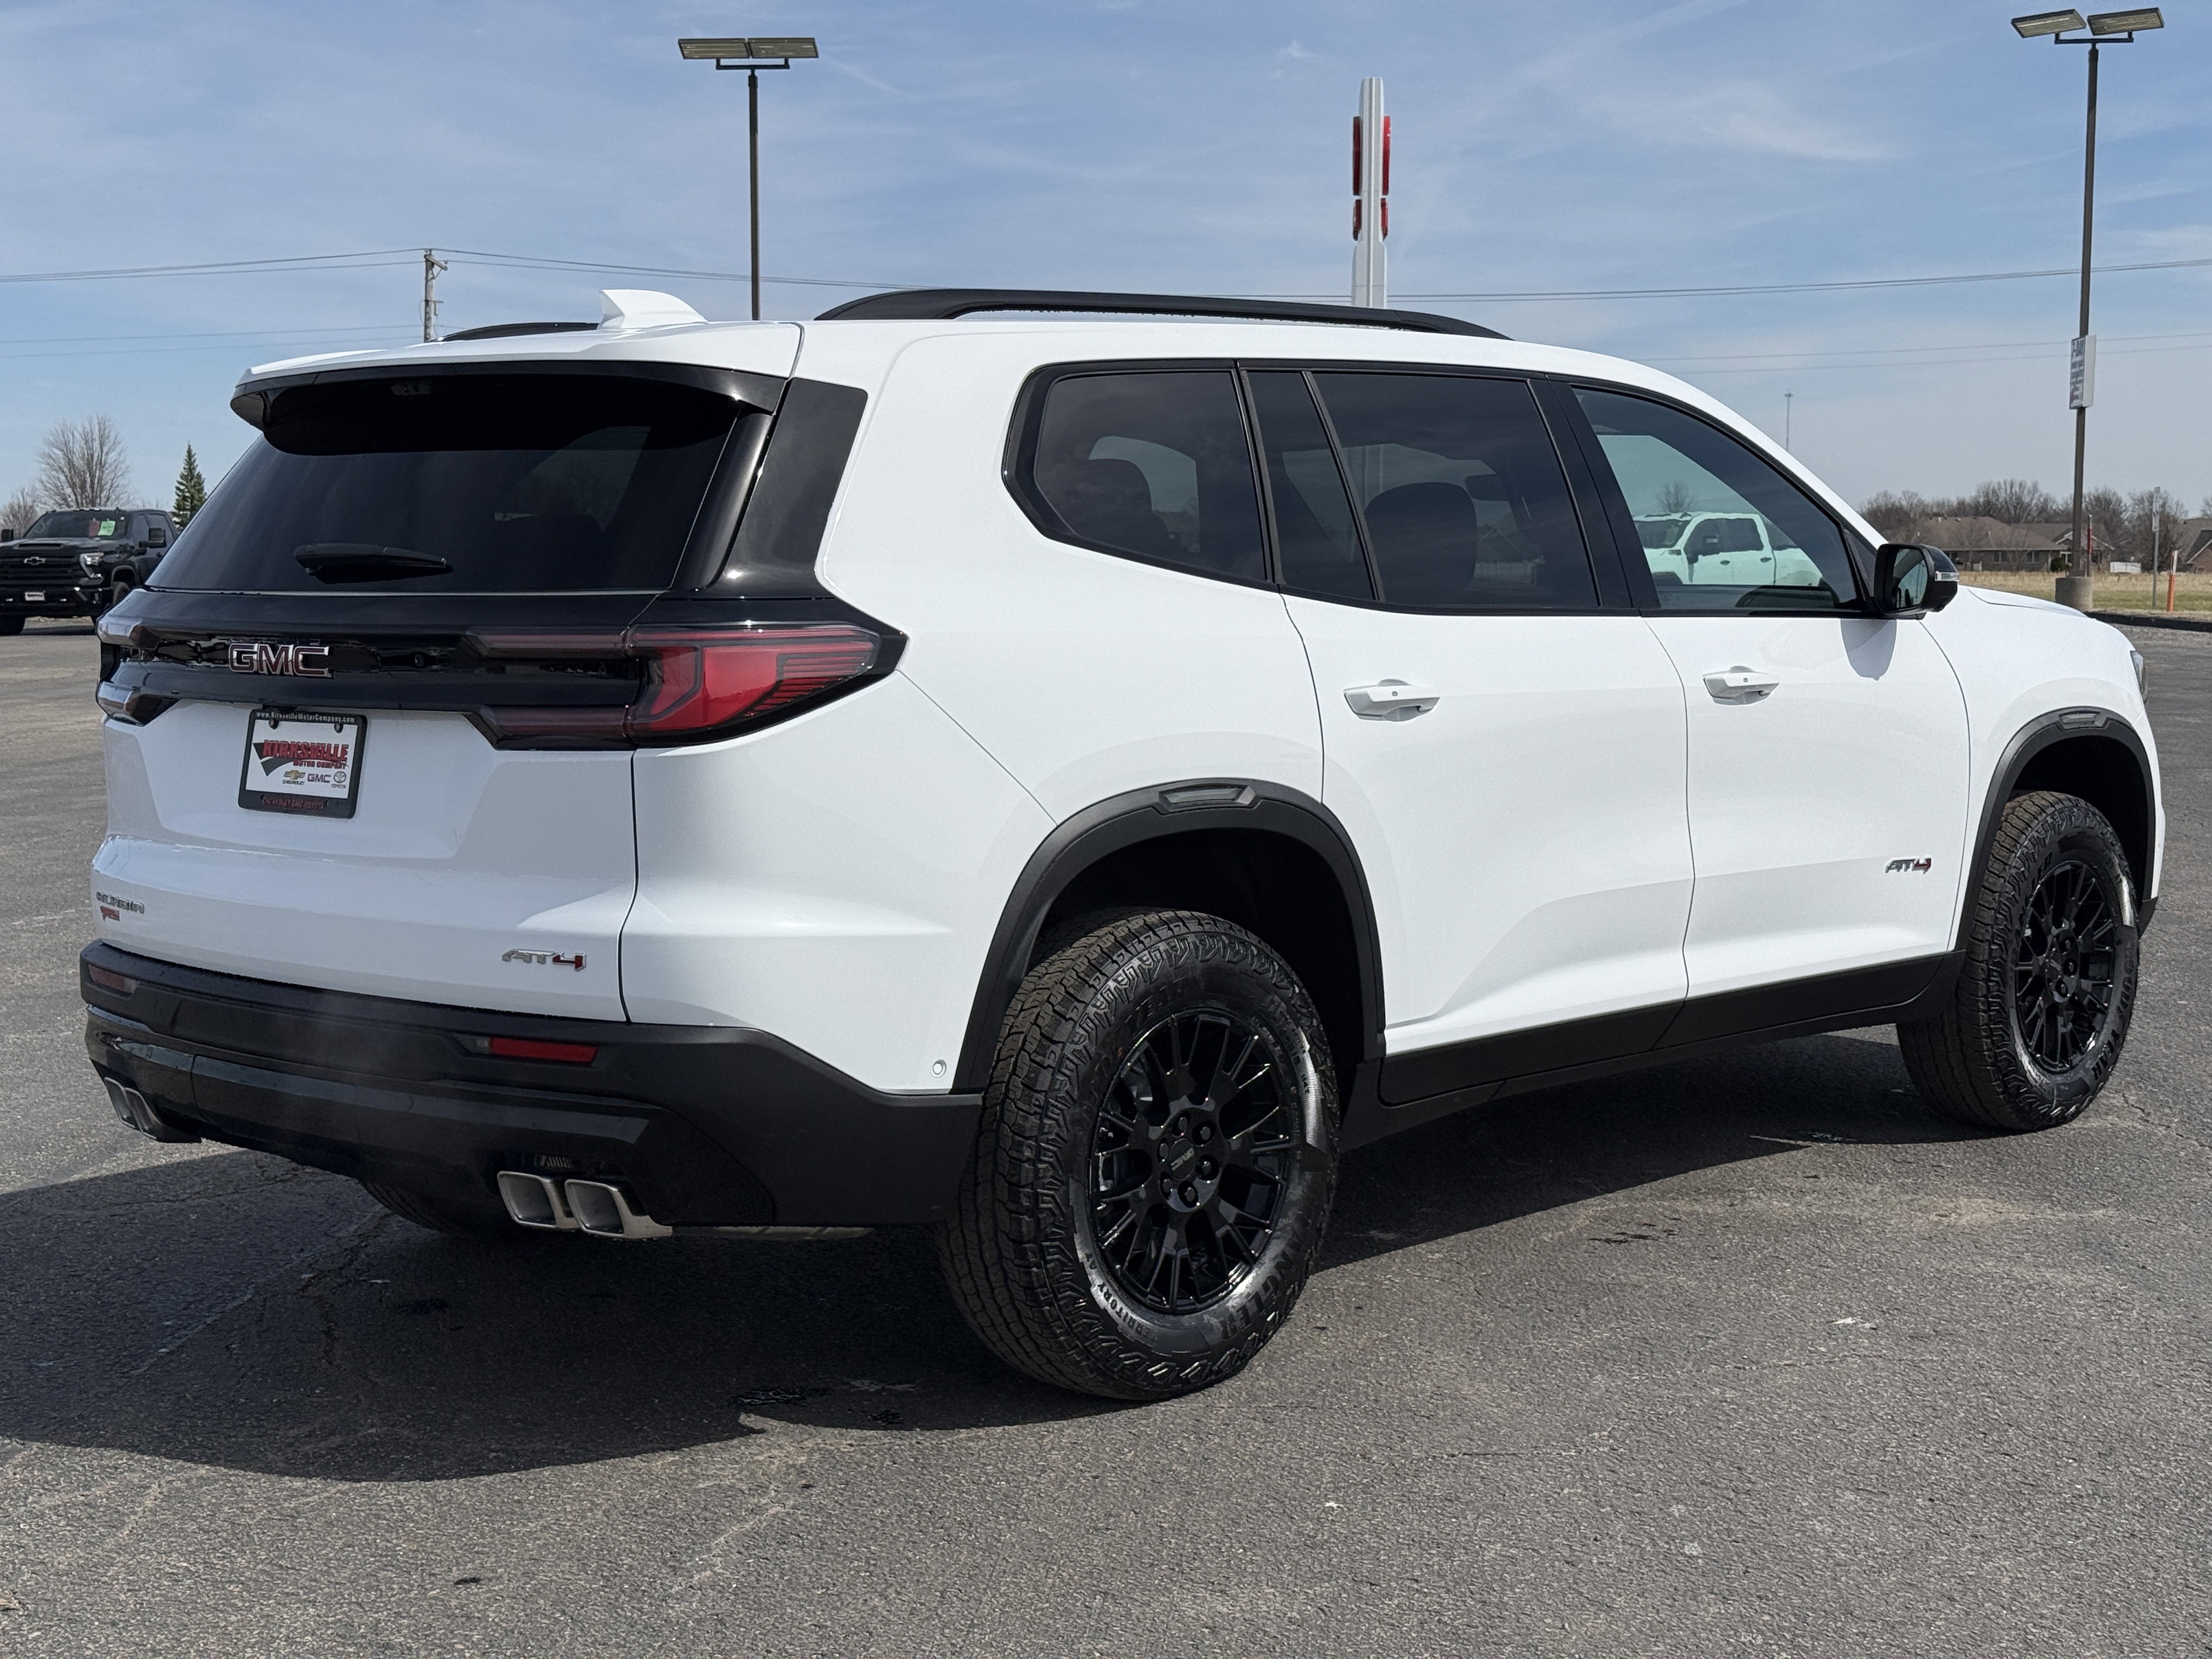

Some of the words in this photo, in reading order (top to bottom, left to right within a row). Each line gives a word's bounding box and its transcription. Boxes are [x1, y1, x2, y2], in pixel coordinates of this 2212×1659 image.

[228, 643, 332, 678] GMC
[262, 740, 349, 763] KIRKSVILLE
[316, 761, 346, 770] COMPANY
[307, 773, 331, 783] GMC
[1885, 857, 1931, 874] AT4
[502, 949, 586, 972] AT4
